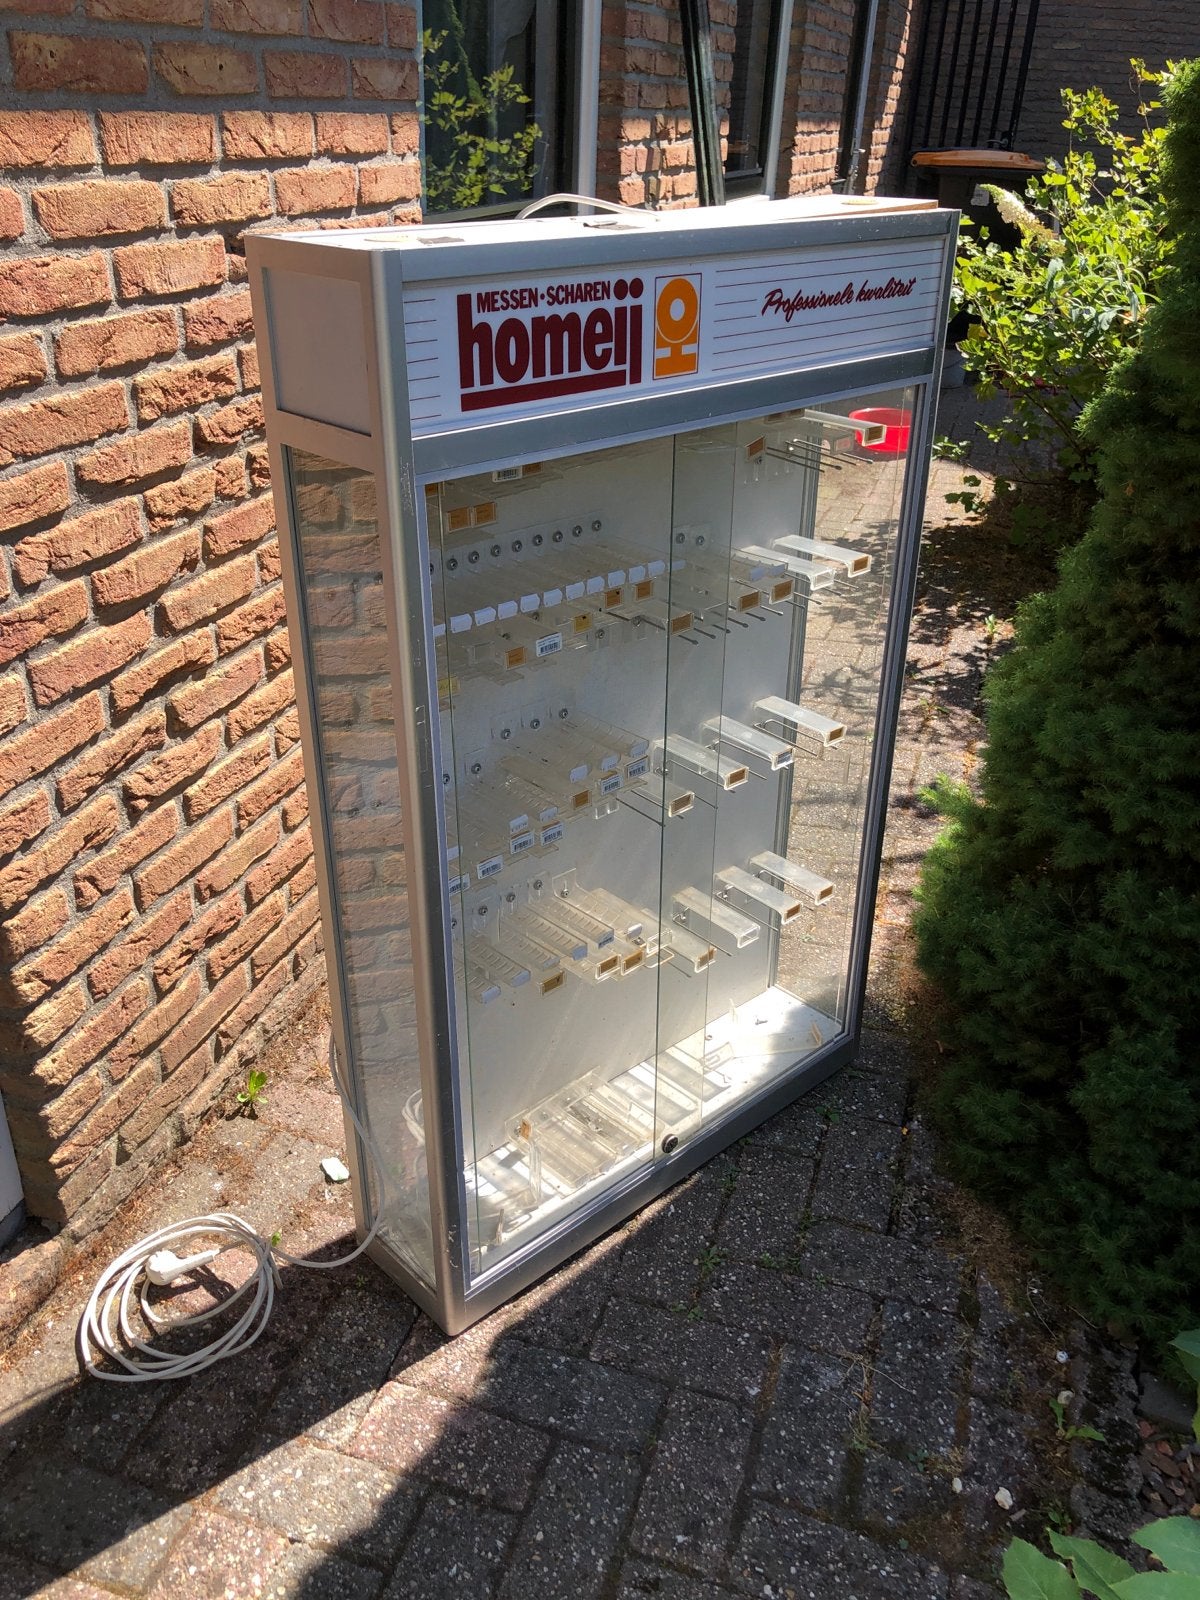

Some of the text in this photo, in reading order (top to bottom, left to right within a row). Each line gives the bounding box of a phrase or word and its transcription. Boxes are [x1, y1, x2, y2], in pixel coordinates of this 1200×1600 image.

[457, 277, 644, 389] homeij
[761, 276, 917, 322] Professionele kwaliteit
